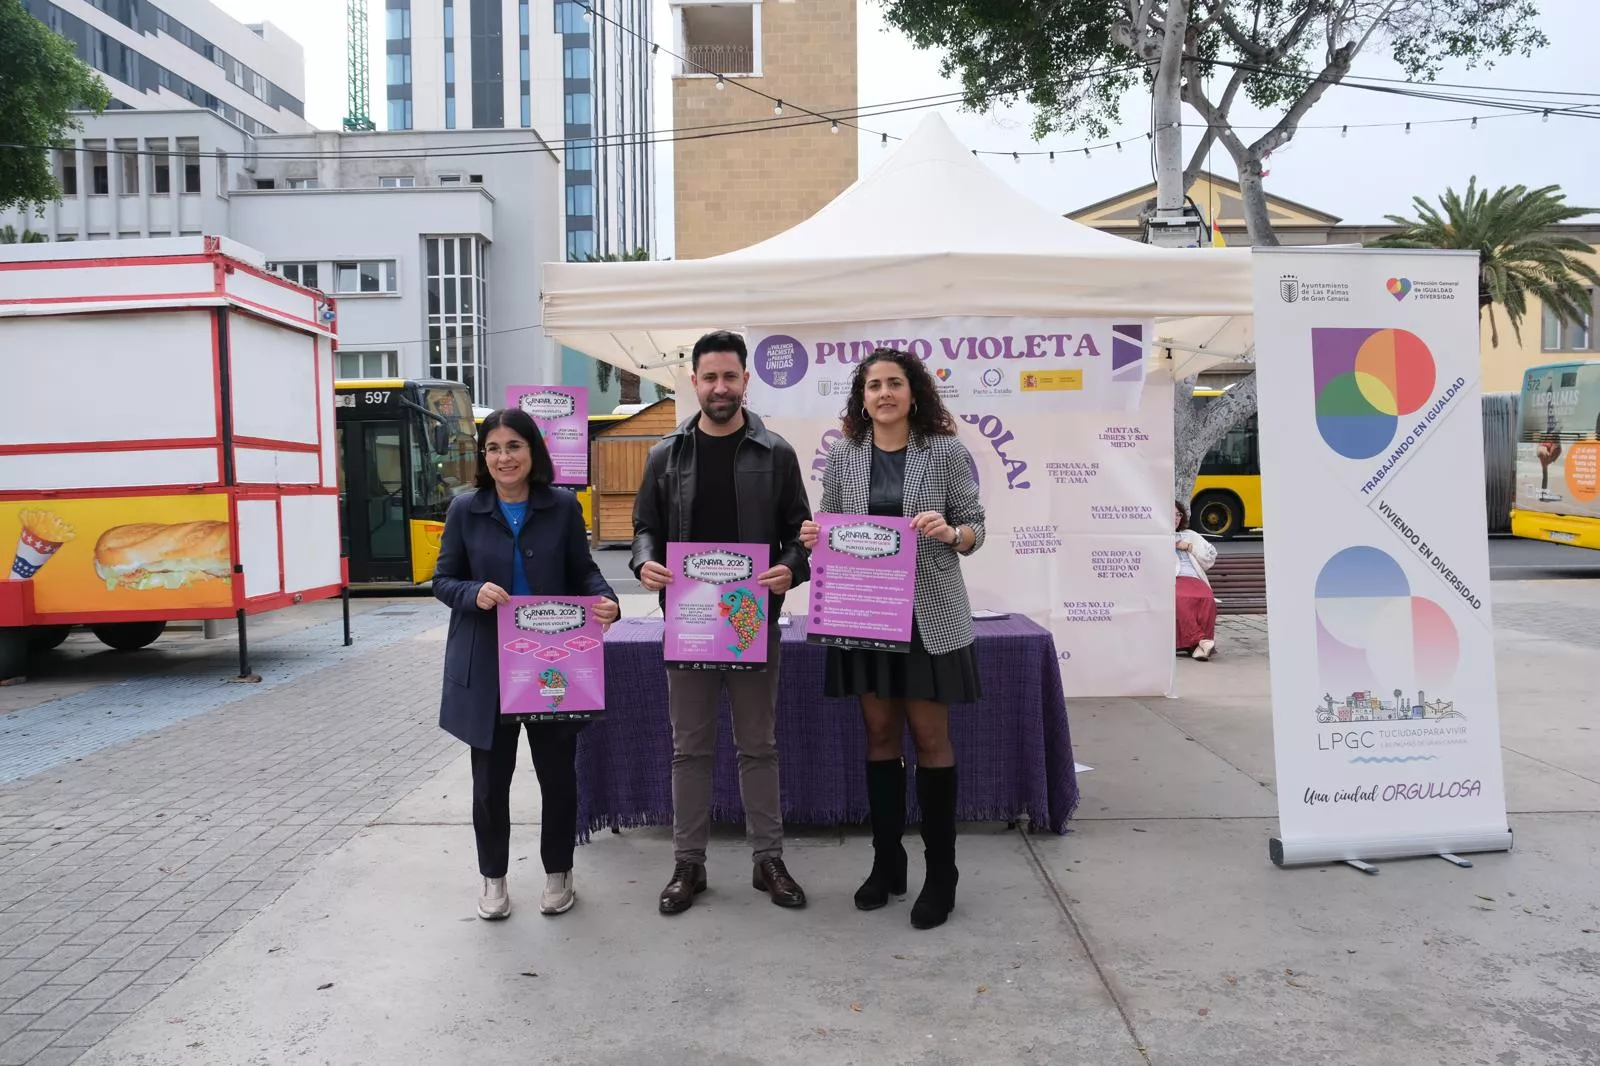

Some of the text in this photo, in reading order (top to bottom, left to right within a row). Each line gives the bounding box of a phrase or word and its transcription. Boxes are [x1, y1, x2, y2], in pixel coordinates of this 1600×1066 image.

[1301, 282, 1349, 290] Ayuntamiento
[815, 333, 1102, 365] PUNTO VIOLETA
[765, 359, 793, 370] UNIDAS
[365, 391, 391, 404] 597
[1361, 435, 1415, 495] TRABAJANDO
[1425, 377, 1465, 424] IGUALDAD
[837, 530, 892, 541] CARNAVAL 2026
[1378, 500, 1421, 546] VIVIENDO
[1431, 557, 1481, 610] DIVERSIDAD
[691, 558, 725, 569] CARNAVAL
[523, 609, 557, 620] CARNAVAL
[1379, 726, 1467, 738] TU CIUDAD PARA VIVIR
[1318, 731, 1375, 750] LPGC
[1303, 779, 1482, 805] Una ciudad ORGULLOSA
